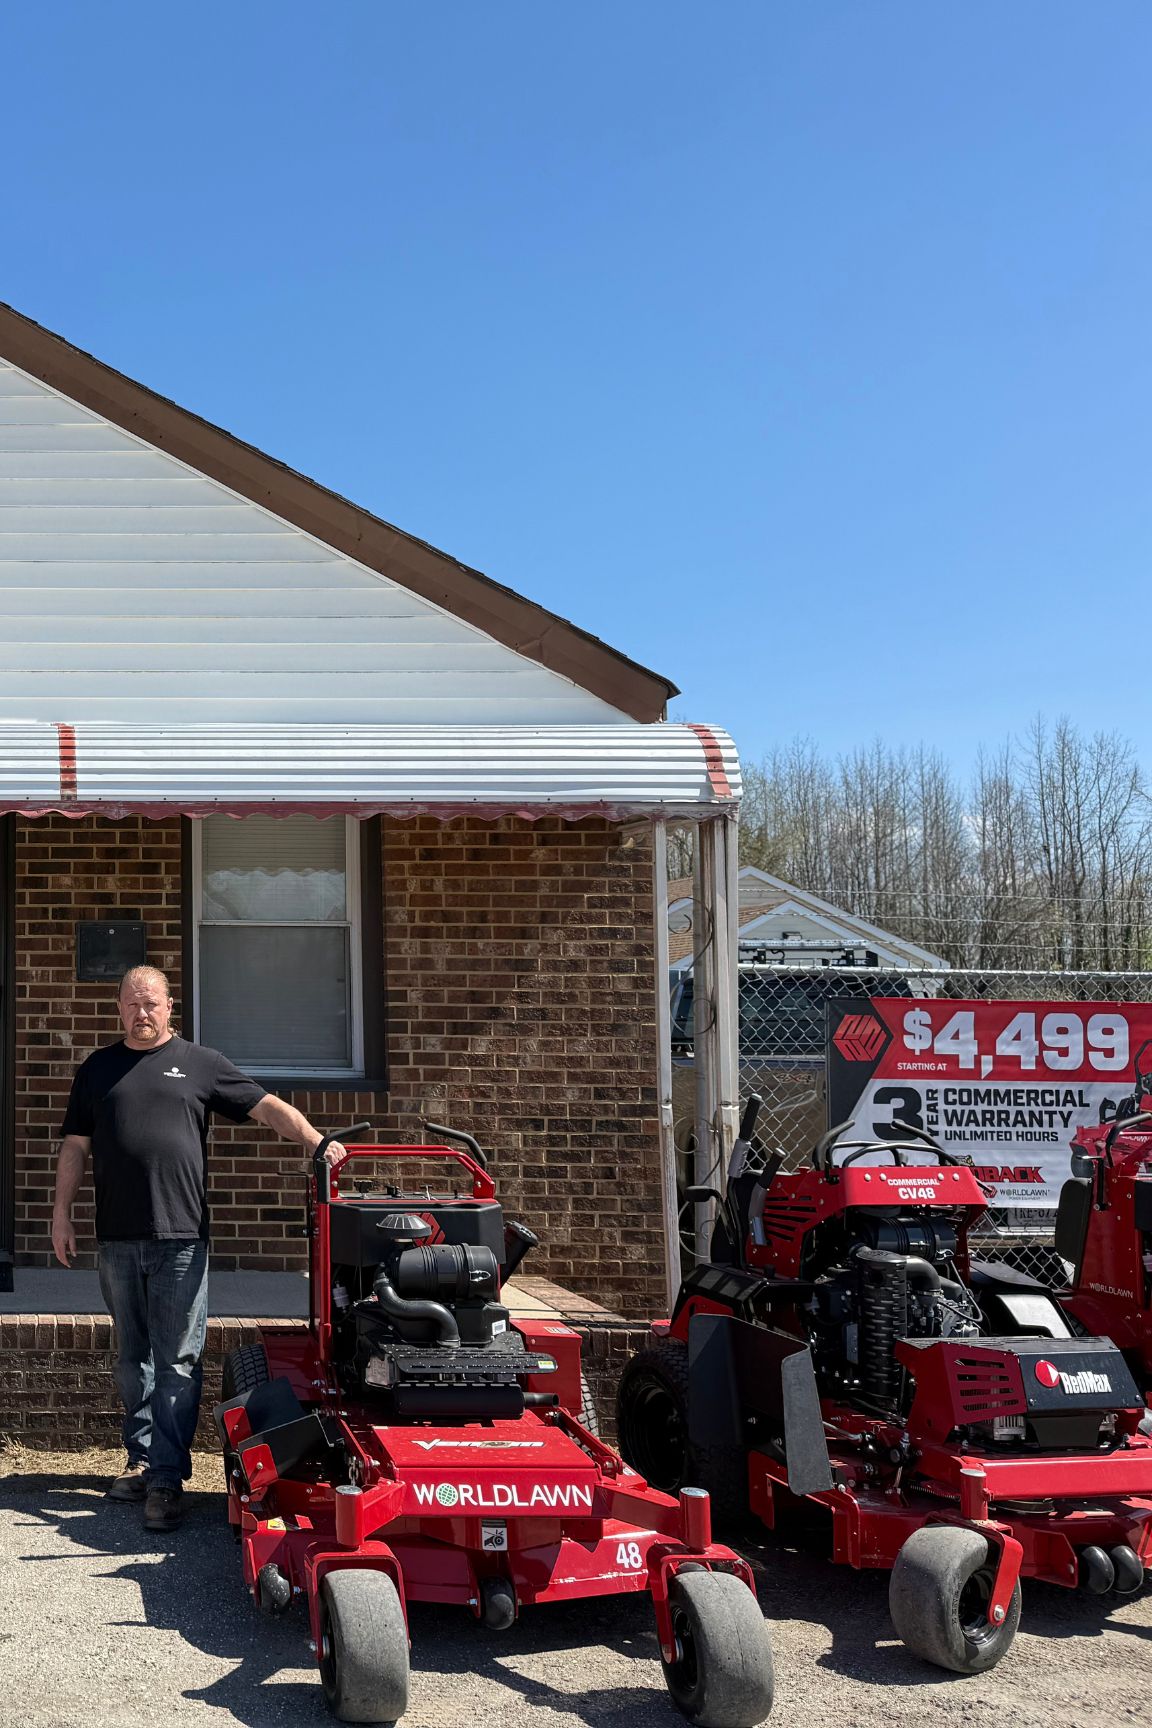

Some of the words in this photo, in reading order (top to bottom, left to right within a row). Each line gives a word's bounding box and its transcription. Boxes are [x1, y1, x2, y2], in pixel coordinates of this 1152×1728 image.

[903, 1007, 1130, 1080] $4,499
[897, 1062, 935, 1071] STARTING
[936, 1063, 947, 1071] AT
[943, 1087, 1090, 1108] COMMERCIAL
[872, 1086, 924, 1141] 3
[926, 1088, 940, 1138] YEAR
[943, 1108, 1074, 1129] WARRANTY
[944, 1130, 1012, 1142] UNLIMITED
[1015, 1131, 1059, 1142] HOURS
[887, 1178, 940, 1186] COMMERCIAL
[898, 1187, 936, 1200] CV48
[1089, 1282, 1134, 1299] WORLDLAWN
[1058, 1371, 1113, 1395] RedMax
[412, 1482, 593, 1507] WORLDLAWN
[616, 1542, 643, 1569] 48
